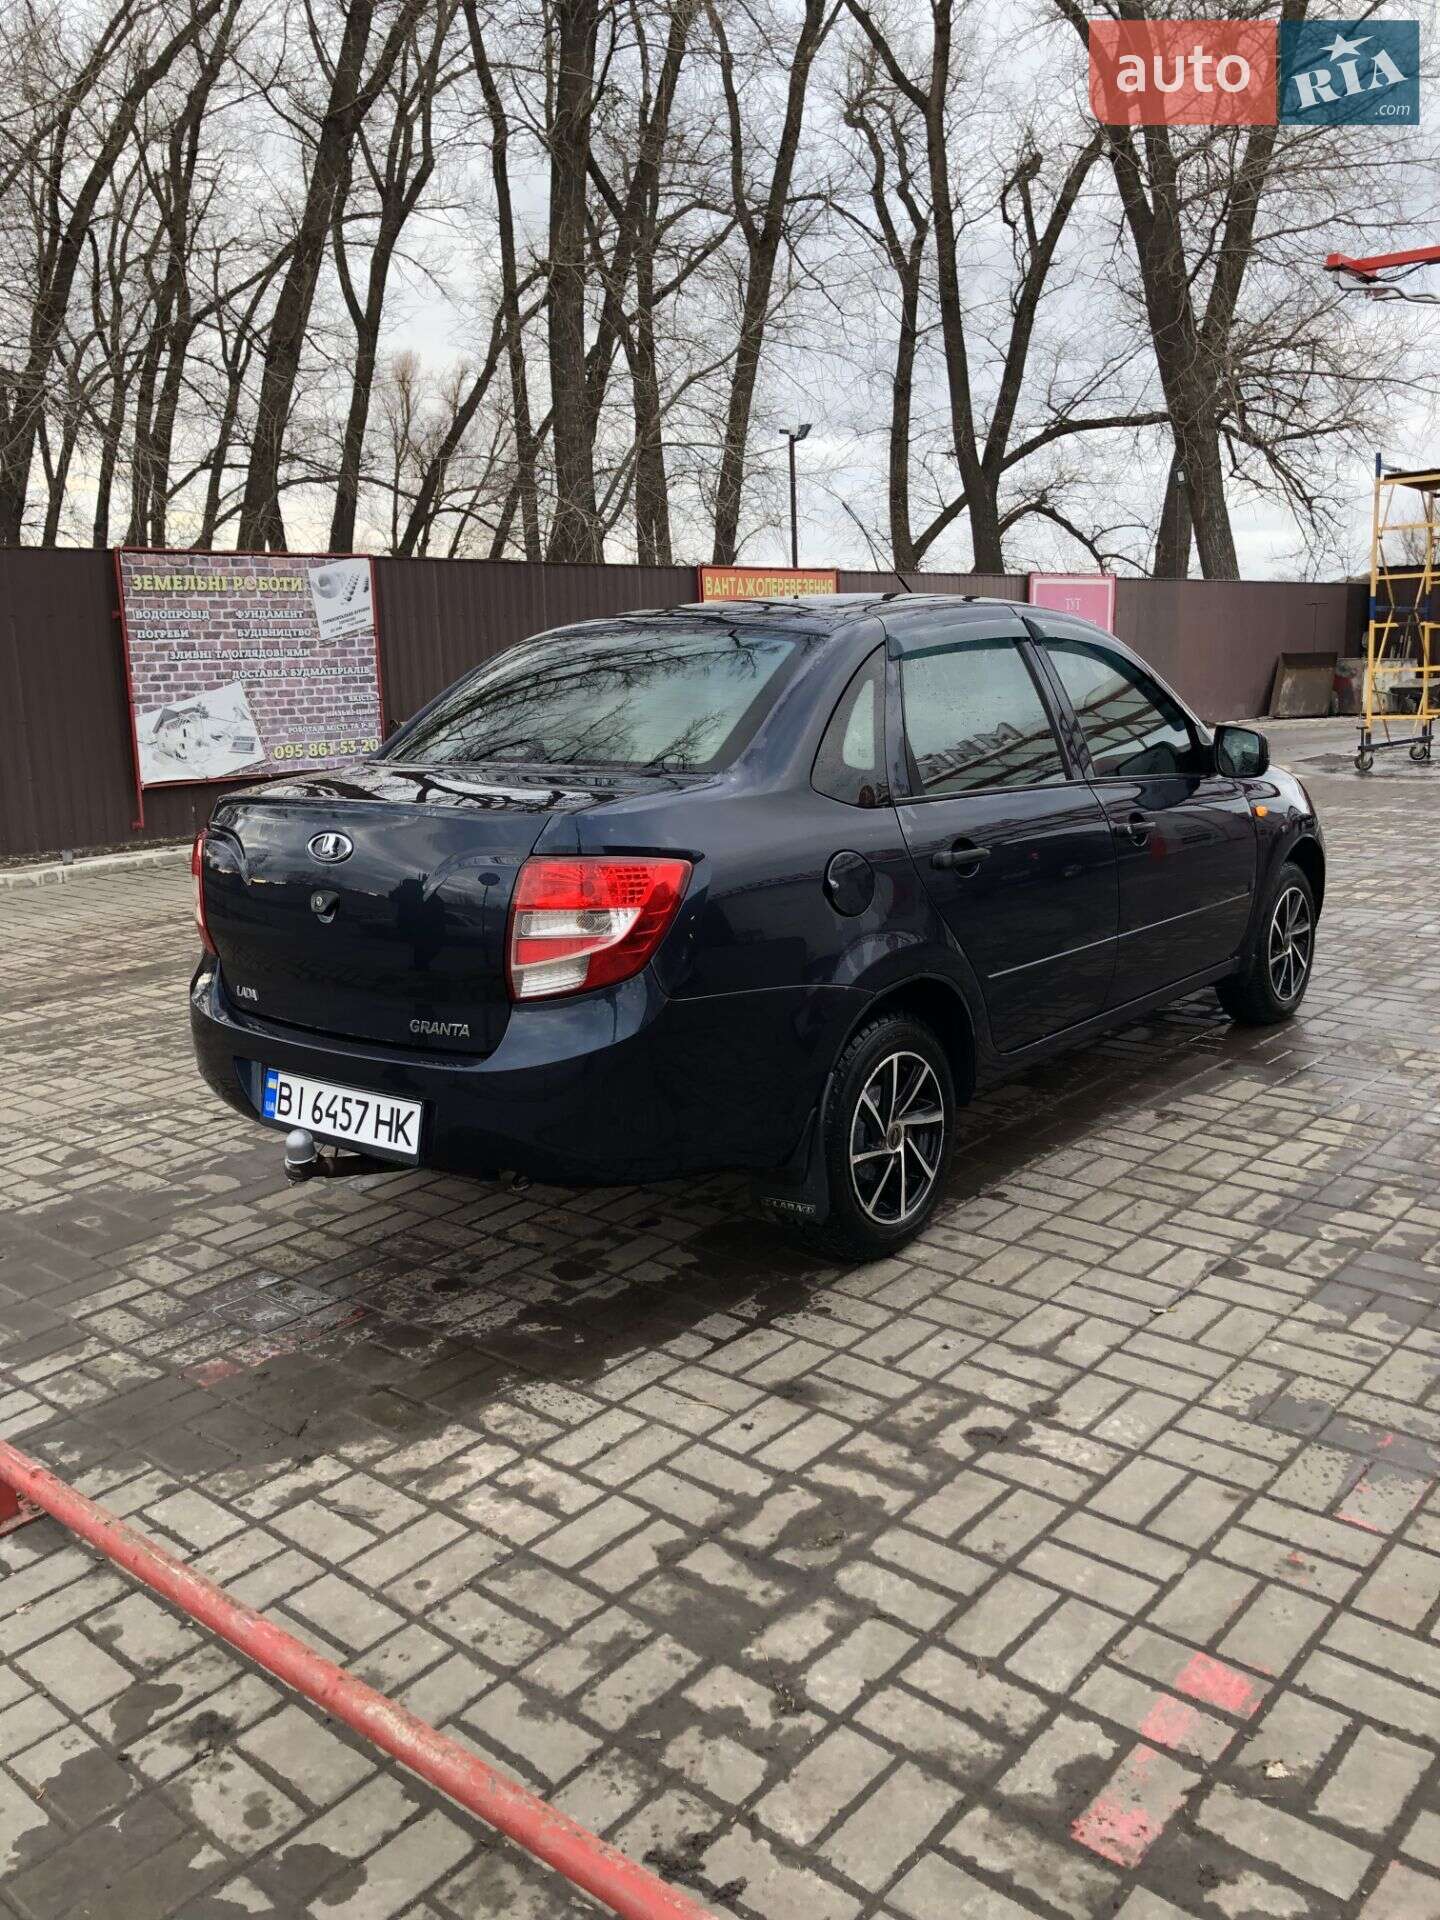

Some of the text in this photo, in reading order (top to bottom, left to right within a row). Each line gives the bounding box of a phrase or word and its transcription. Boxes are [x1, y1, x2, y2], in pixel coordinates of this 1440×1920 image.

[131, 574, 305, 592] ЗЕМЕЛЬНІ РОБОТИ
[134, 609, 211, 621] ВОДОПРОВІД
[235, 609, 304, 621] ФУНДАМЕНТ
[136, 629, 190, 640] ПОГРЕБИ
[236, 628, 312, 639] БУДІВНИЦТВО
[168, 648, 311, 660] ЗЛИВНІ ТА ОГЛЯДОВІ ЯМИ
[231, 666, 371, 681] ДОСТАВКА БУДМАТЕРІАЛІВ
[273, 743, 304, 760] 095
[308, 741, 336, 758] 861
[361, 738, 379, 753] 20
[409, 1019, 471, 1039] GRANTA
[277, 1081, 416, 1147] BI 6457 HK
